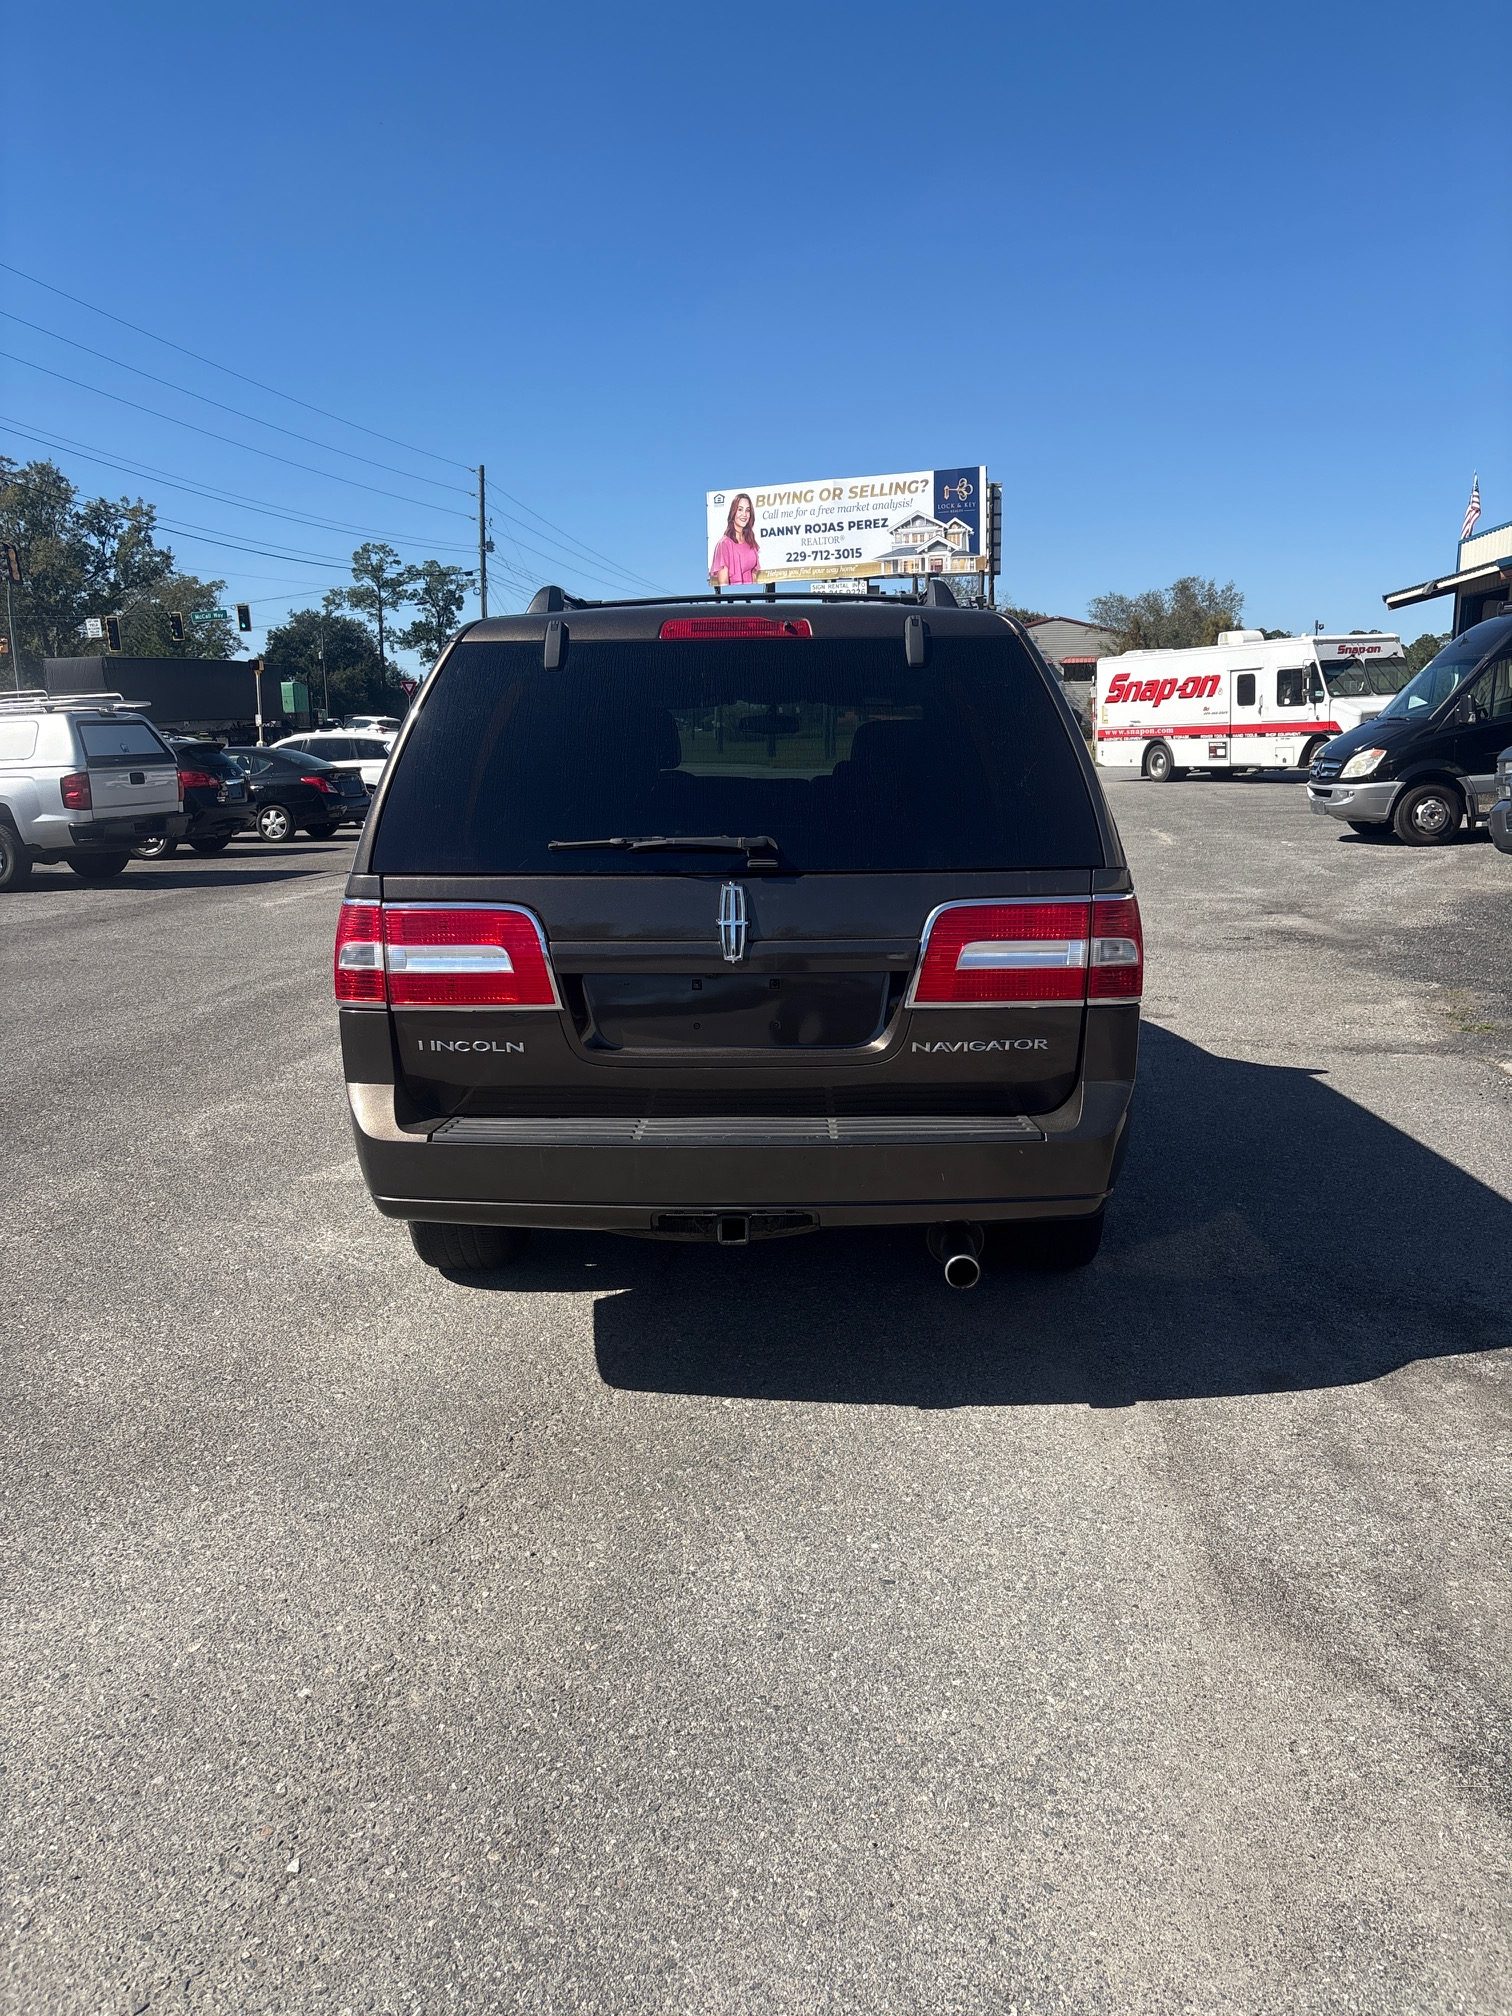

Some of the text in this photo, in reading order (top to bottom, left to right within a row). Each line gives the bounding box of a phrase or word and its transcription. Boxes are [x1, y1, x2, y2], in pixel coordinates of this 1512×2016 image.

[755, 479, 929, 508] BUYING OR SELLING?
[762, 509, 779, 520] Call
[794, 506, 807, 520] for
[816, 505, 835, 518] free
[837, 502, 870, 513] market
[872, 498, 914, 511] analysis!
[937, 502, 955, 510] LOCK
[760, 517, 889, 538] DANNY ROJAS PEREZ
[786, 547, 862, 562] 229-712-3015
[1337, 645, 1381, 656] Snap-on
[1104, 672, 1221, 708] Snap-on
[1104, 727, 1174, 736] www.snapon.com
[911, 1038, 1049, 1053] NAVIGATOR
